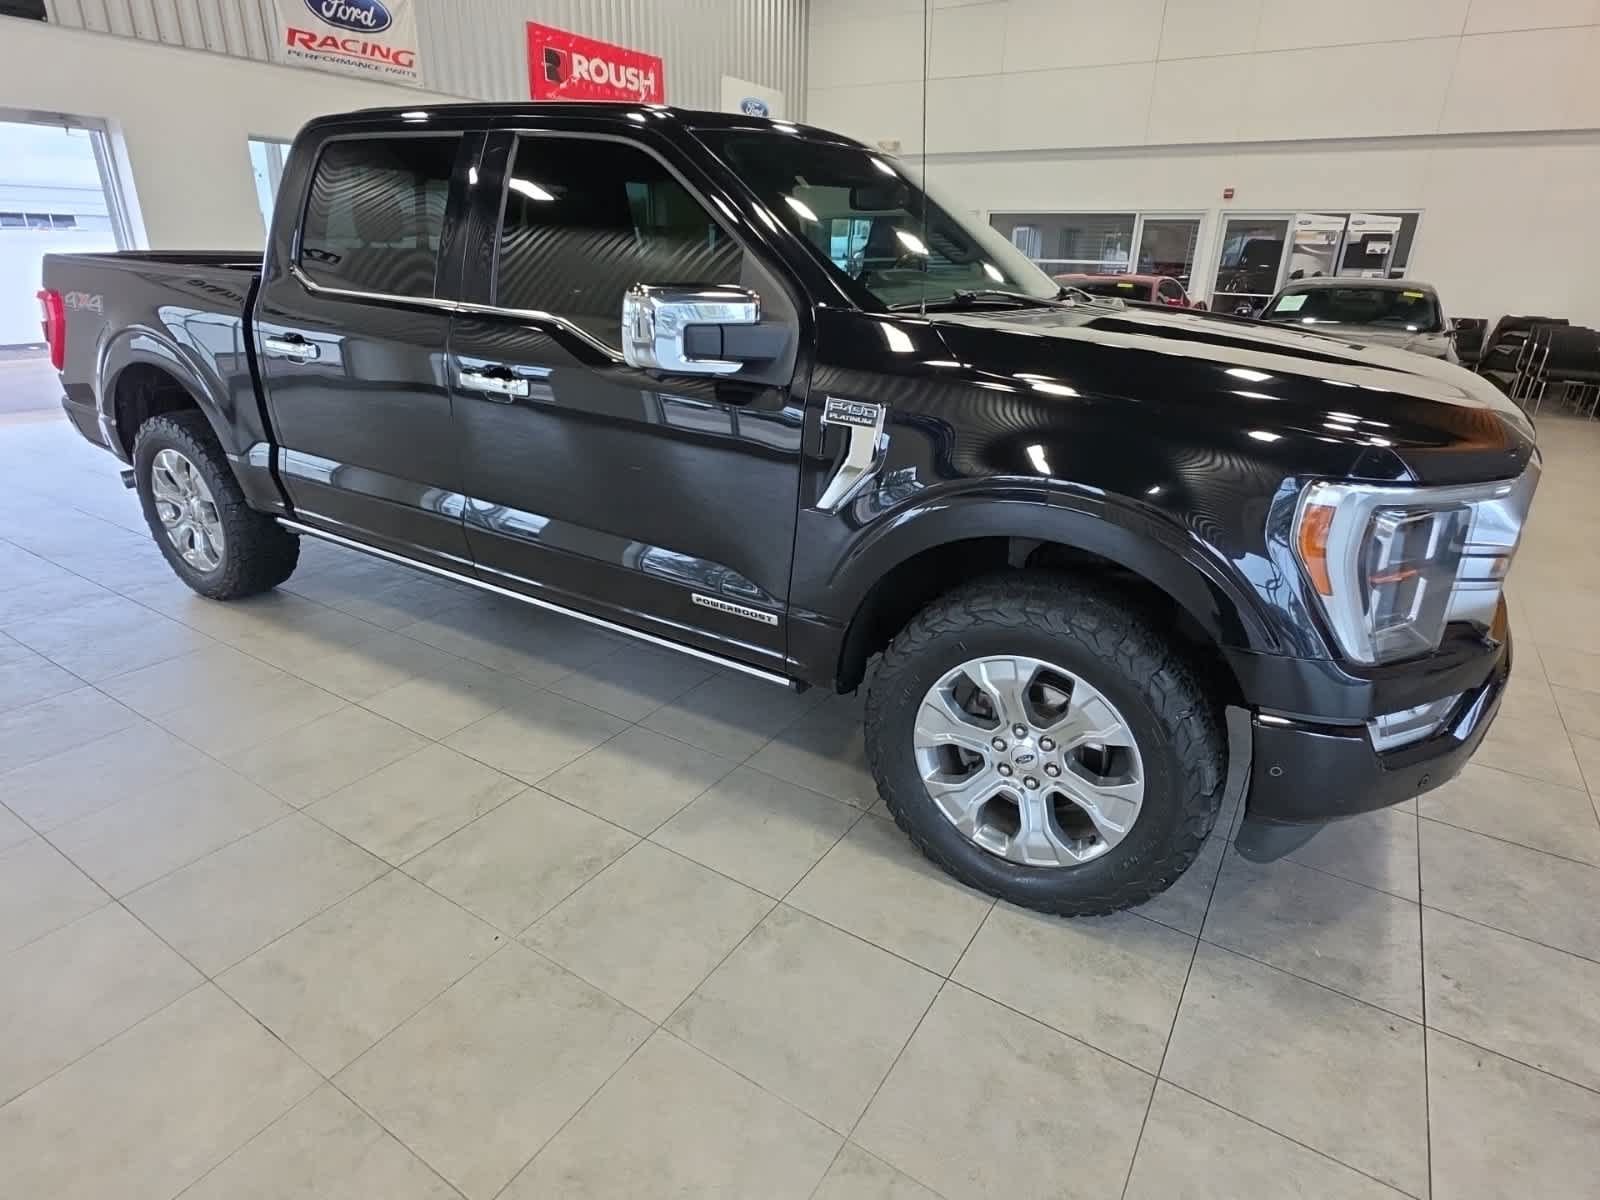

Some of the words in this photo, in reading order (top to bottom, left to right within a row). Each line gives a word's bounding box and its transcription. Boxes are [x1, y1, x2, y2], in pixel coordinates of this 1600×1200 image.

[321, 0, 376, 27] Ford
[287, 28, 417, 68] RACING
[288, 49, 382, 72] PERFORMANCE
[385, 67, 417, 78] PARTS
[572, 53, 656, 97] ROUSH
[829, 412, 873, 425] PLATINUM
[696, 596, 774, 622] POWERBOOST
